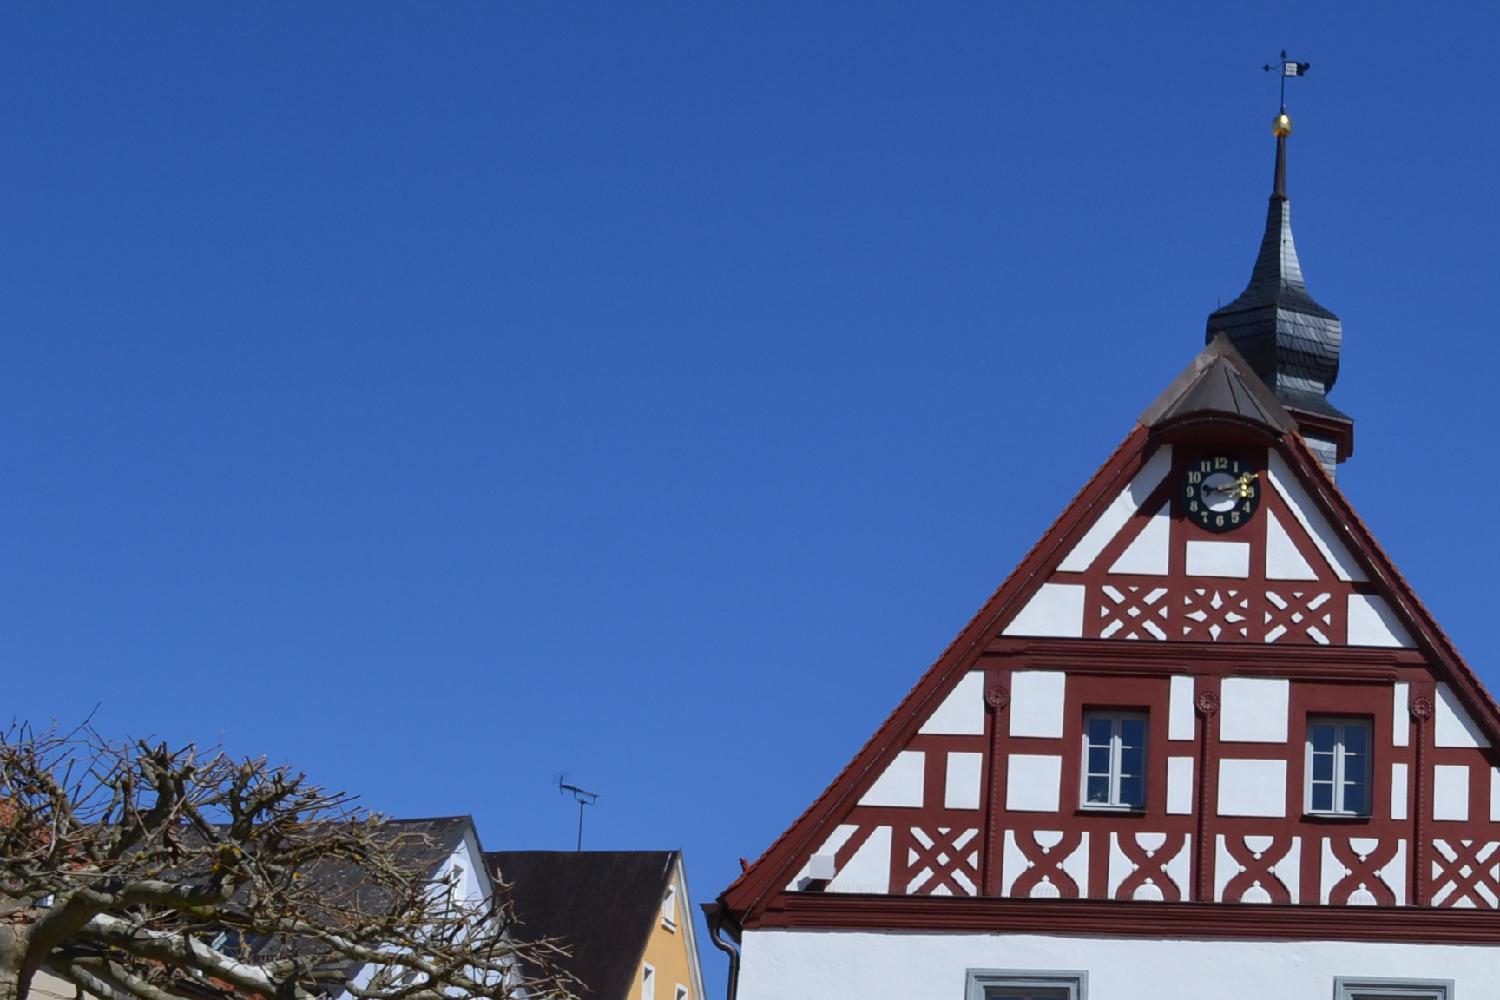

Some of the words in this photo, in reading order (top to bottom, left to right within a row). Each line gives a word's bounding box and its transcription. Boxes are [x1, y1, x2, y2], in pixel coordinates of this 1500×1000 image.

[1200, 461, 1211, 473] 11
[1214, 457, 1227, 469] 12
[1233, 461, 1239, 473] 1
[1188, 471, 1201, 483] 10
[1186, 486, 1194, 497] 9
[1190, 501, 1198, 512] 8
[1242, 501, 1250, 512] 4
[1201, 512, 1208, 523] 7
[1215, 515, 1224, 527] 6
[1232, 512, 1240, 523] 5
